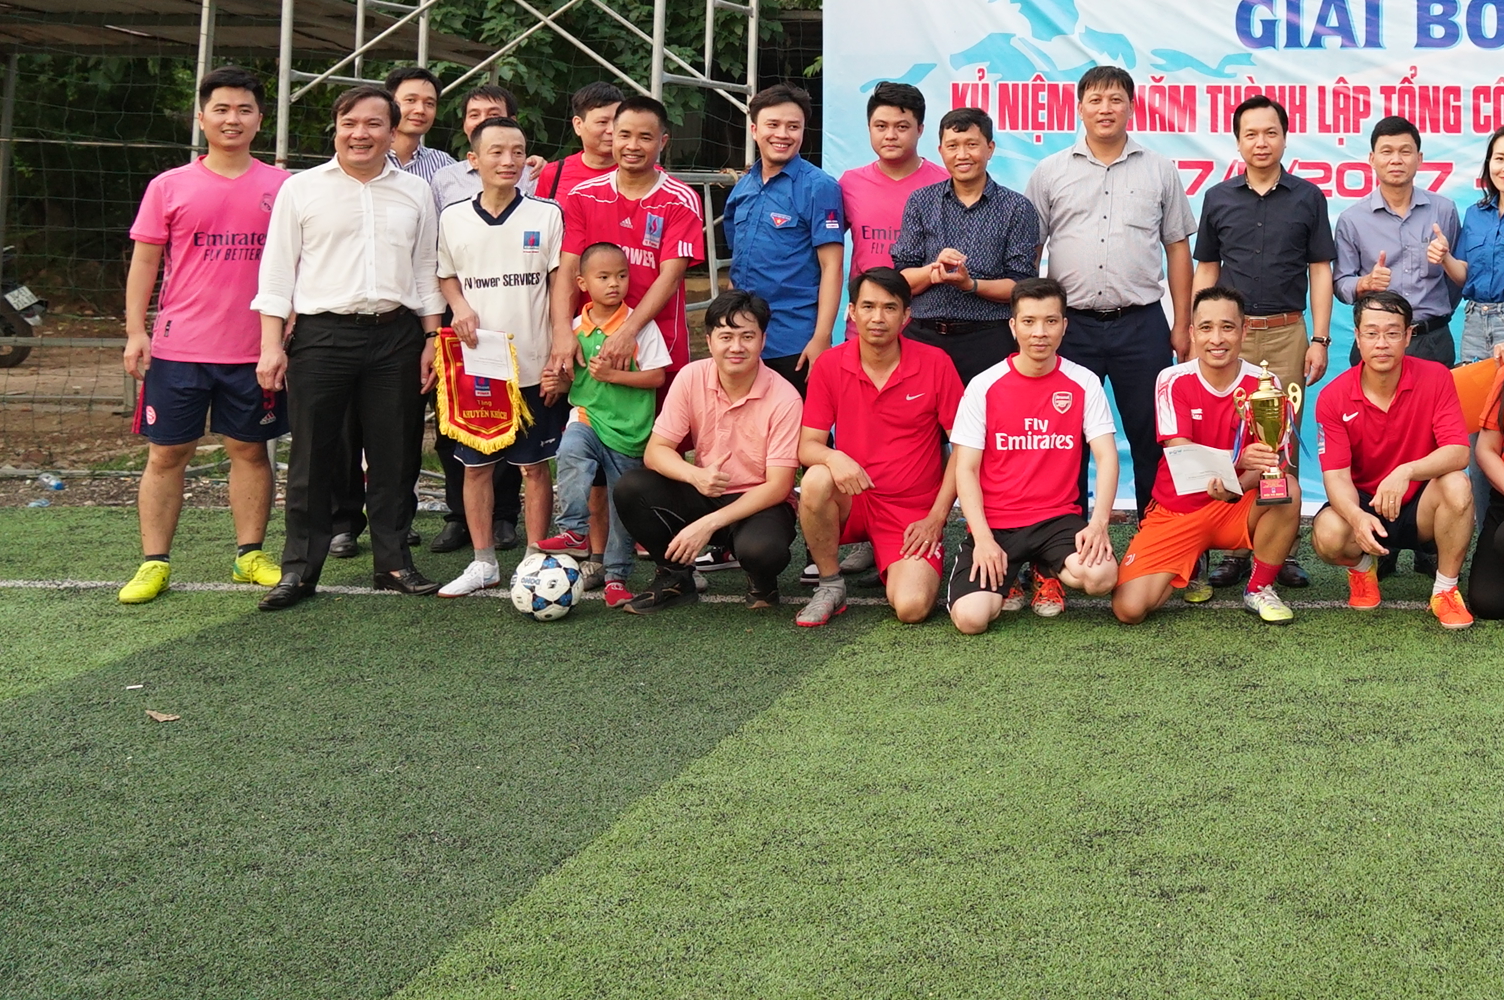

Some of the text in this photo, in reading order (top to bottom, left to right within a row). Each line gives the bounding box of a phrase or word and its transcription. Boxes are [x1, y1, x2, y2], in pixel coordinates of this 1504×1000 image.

[997, 73, 1076, 143] NIỆM
[1317, 75, 1371, 146] LẬP
[1379, 65, 1462, 134] TỔNG
[193, 230, 267, 247] Emirate
[203, 248, 222, 261] FLY
[1024, 417, 1049, 433] Fly
[994, 431, 1074, 451] Emirates
